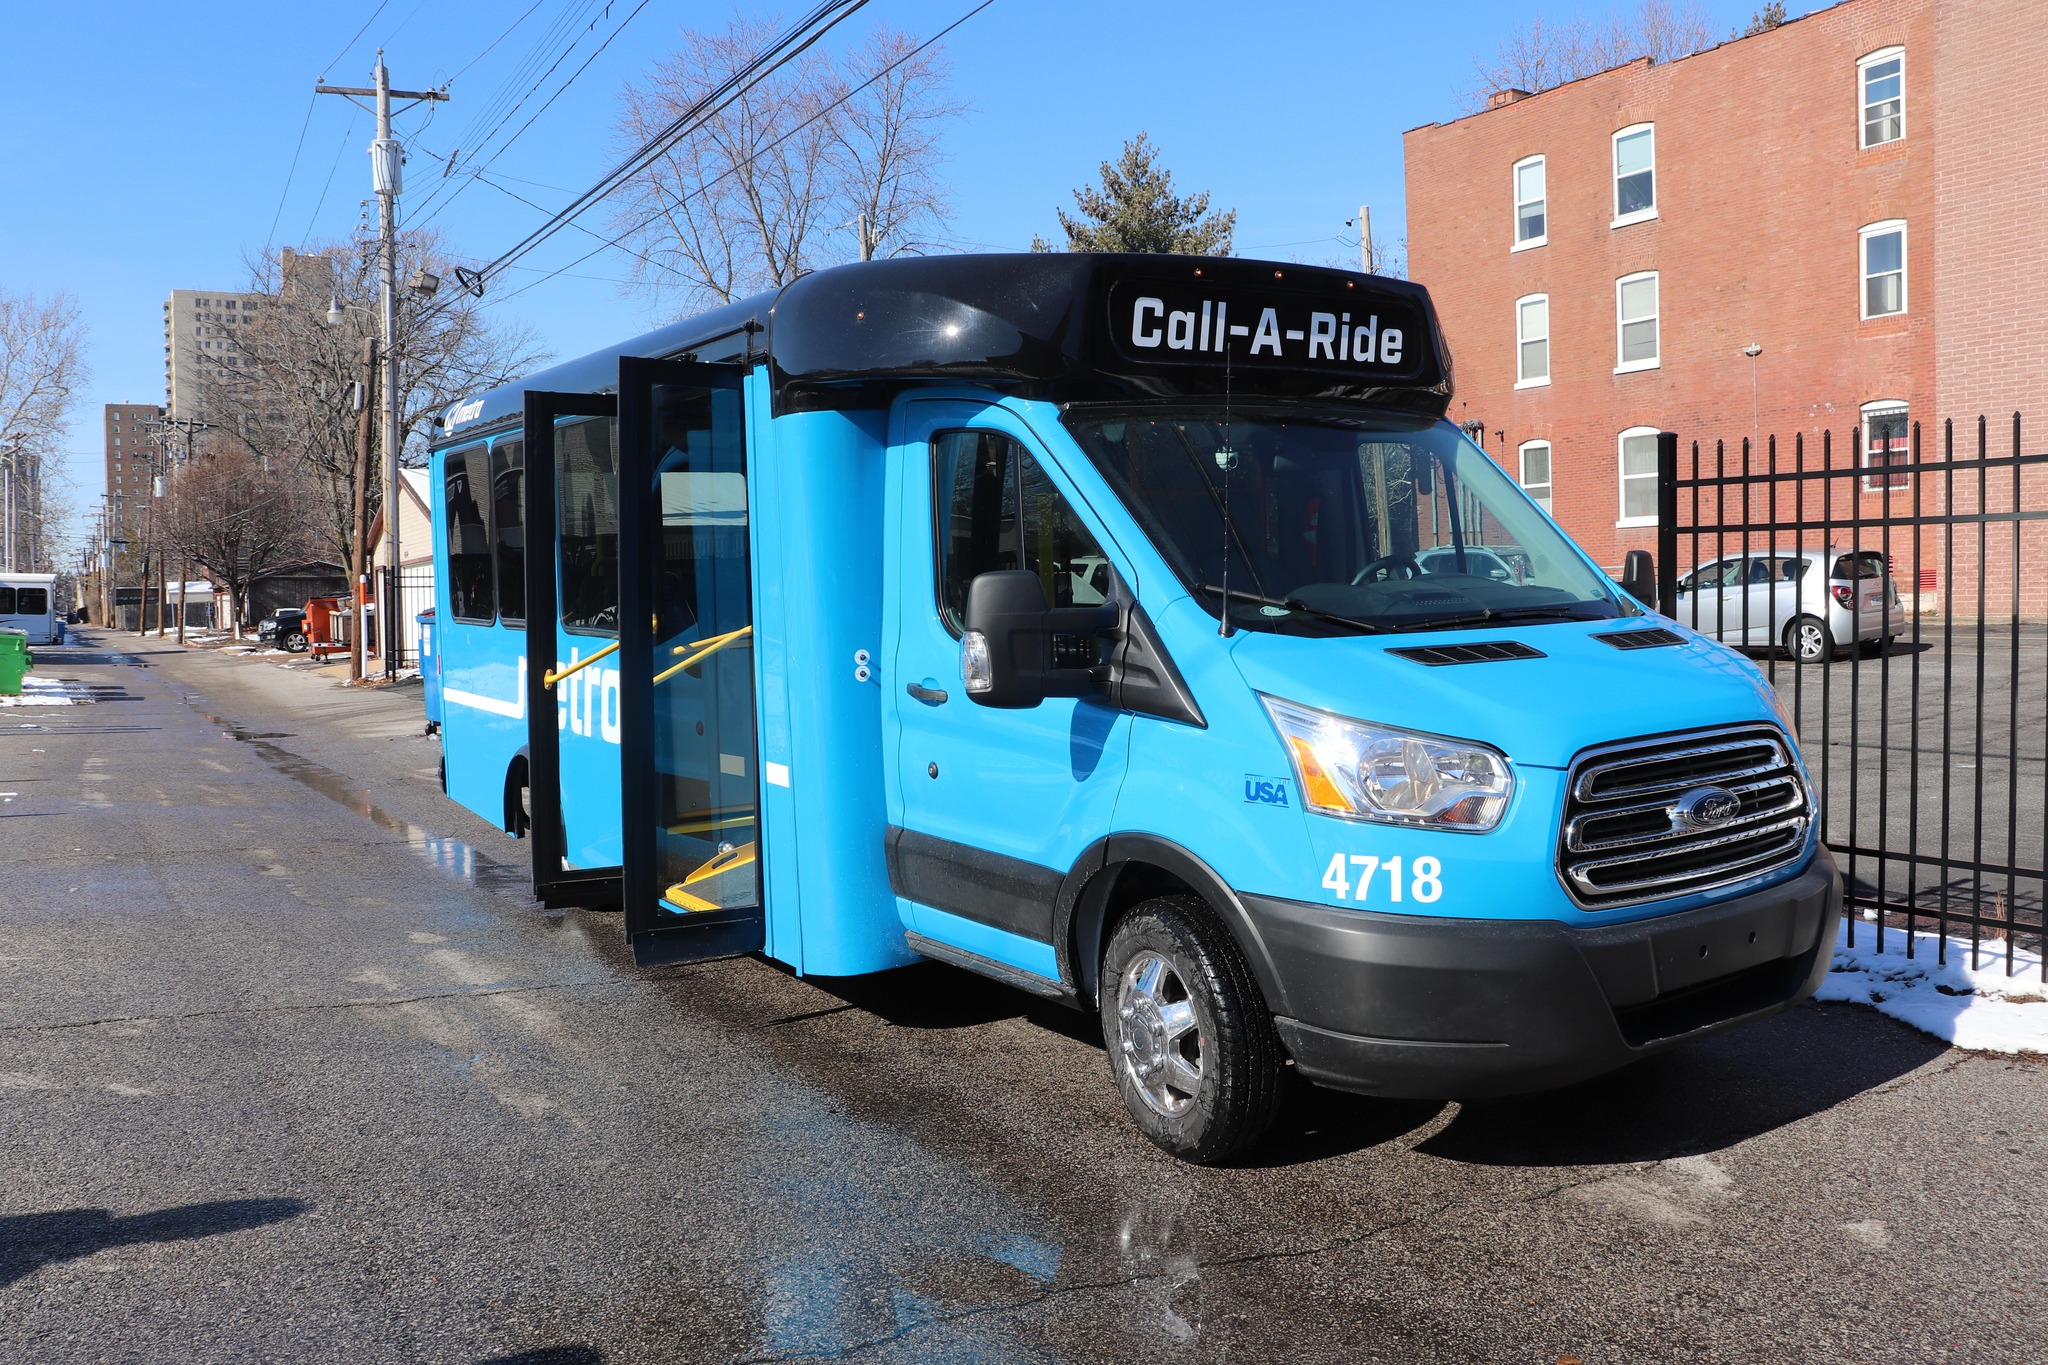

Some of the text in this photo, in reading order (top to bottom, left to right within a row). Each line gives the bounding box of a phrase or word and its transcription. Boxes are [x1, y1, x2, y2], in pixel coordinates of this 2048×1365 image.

[1131, 296, 1403, 364] Call-A-Ride
[518, 647, 622, 745] etro
[1245, 780, 1288, 805] USA
[1702, 797, 1732, 820] Ford
[1321, 853, 1443, 903] 4718
